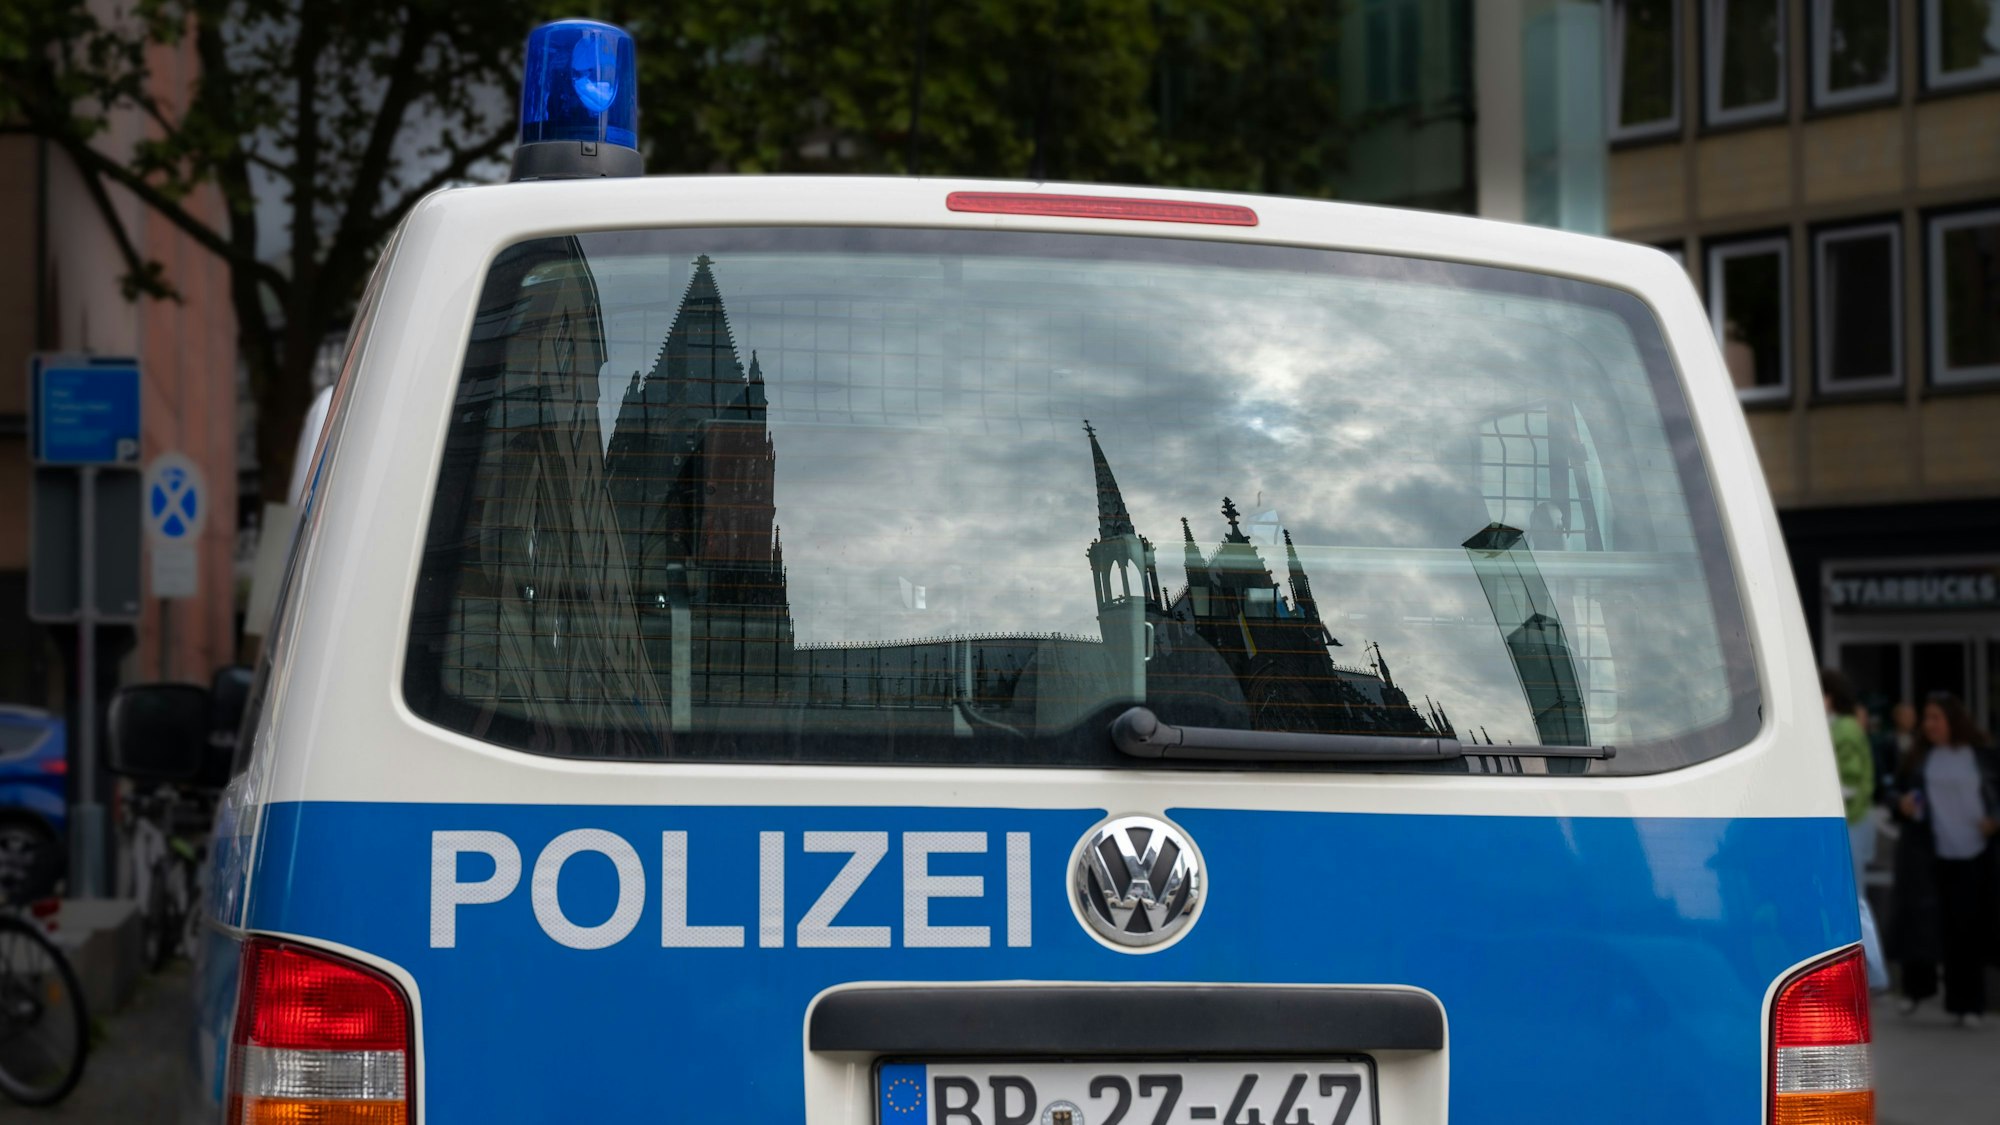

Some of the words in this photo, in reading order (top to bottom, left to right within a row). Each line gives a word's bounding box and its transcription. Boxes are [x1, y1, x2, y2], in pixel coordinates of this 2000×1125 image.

[1830, 575, 1996, 605] STARBUCKS
[430, 827, 1032, 950] POLIZEI
[933, 1074, 1038, 1125] BP
[1088, 1073, 1363, 1125] 27-447
